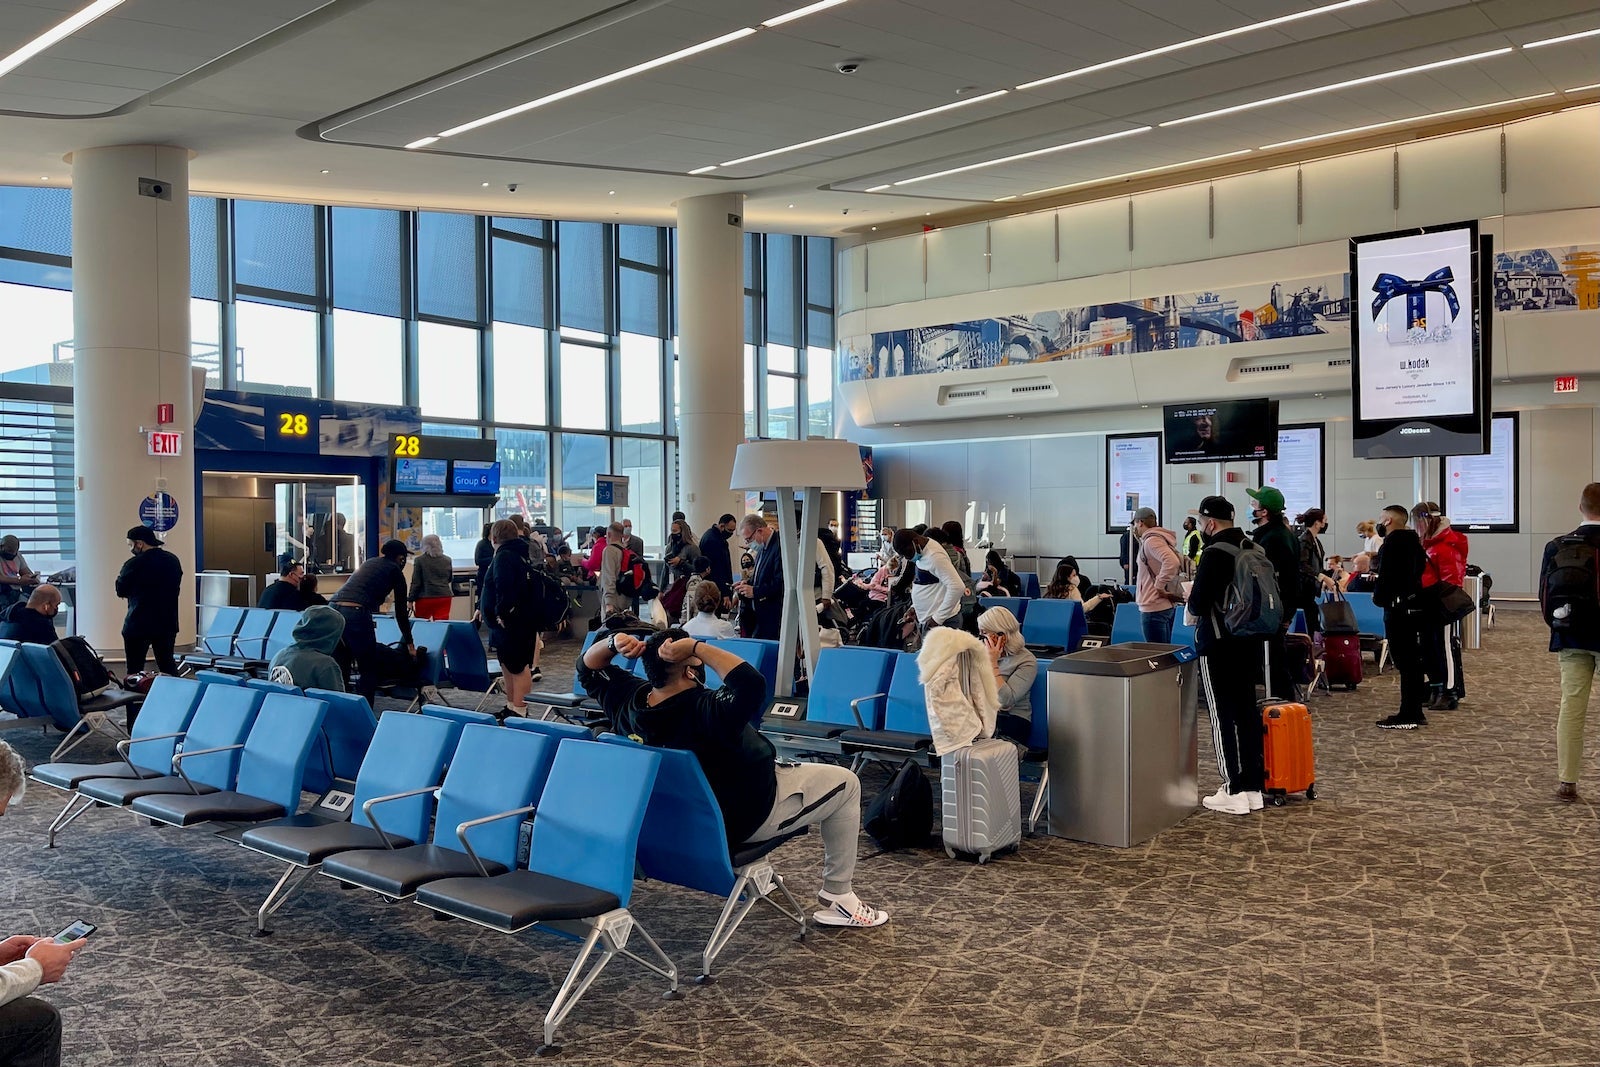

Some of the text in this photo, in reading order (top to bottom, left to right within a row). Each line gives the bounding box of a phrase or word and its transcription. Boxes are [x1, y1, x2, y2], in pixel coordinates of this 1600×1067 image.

[1323, 301, 1341, 315] LONG
[1556, 377, 1576, 391] EXIT
[279, 412, 309, 436] 28
[153, 433, 179, 454] EXIT
[394, 435, 420, 456] 28
[454, 475, 479, 487] Group
[480, 475, 487, 485] 6
